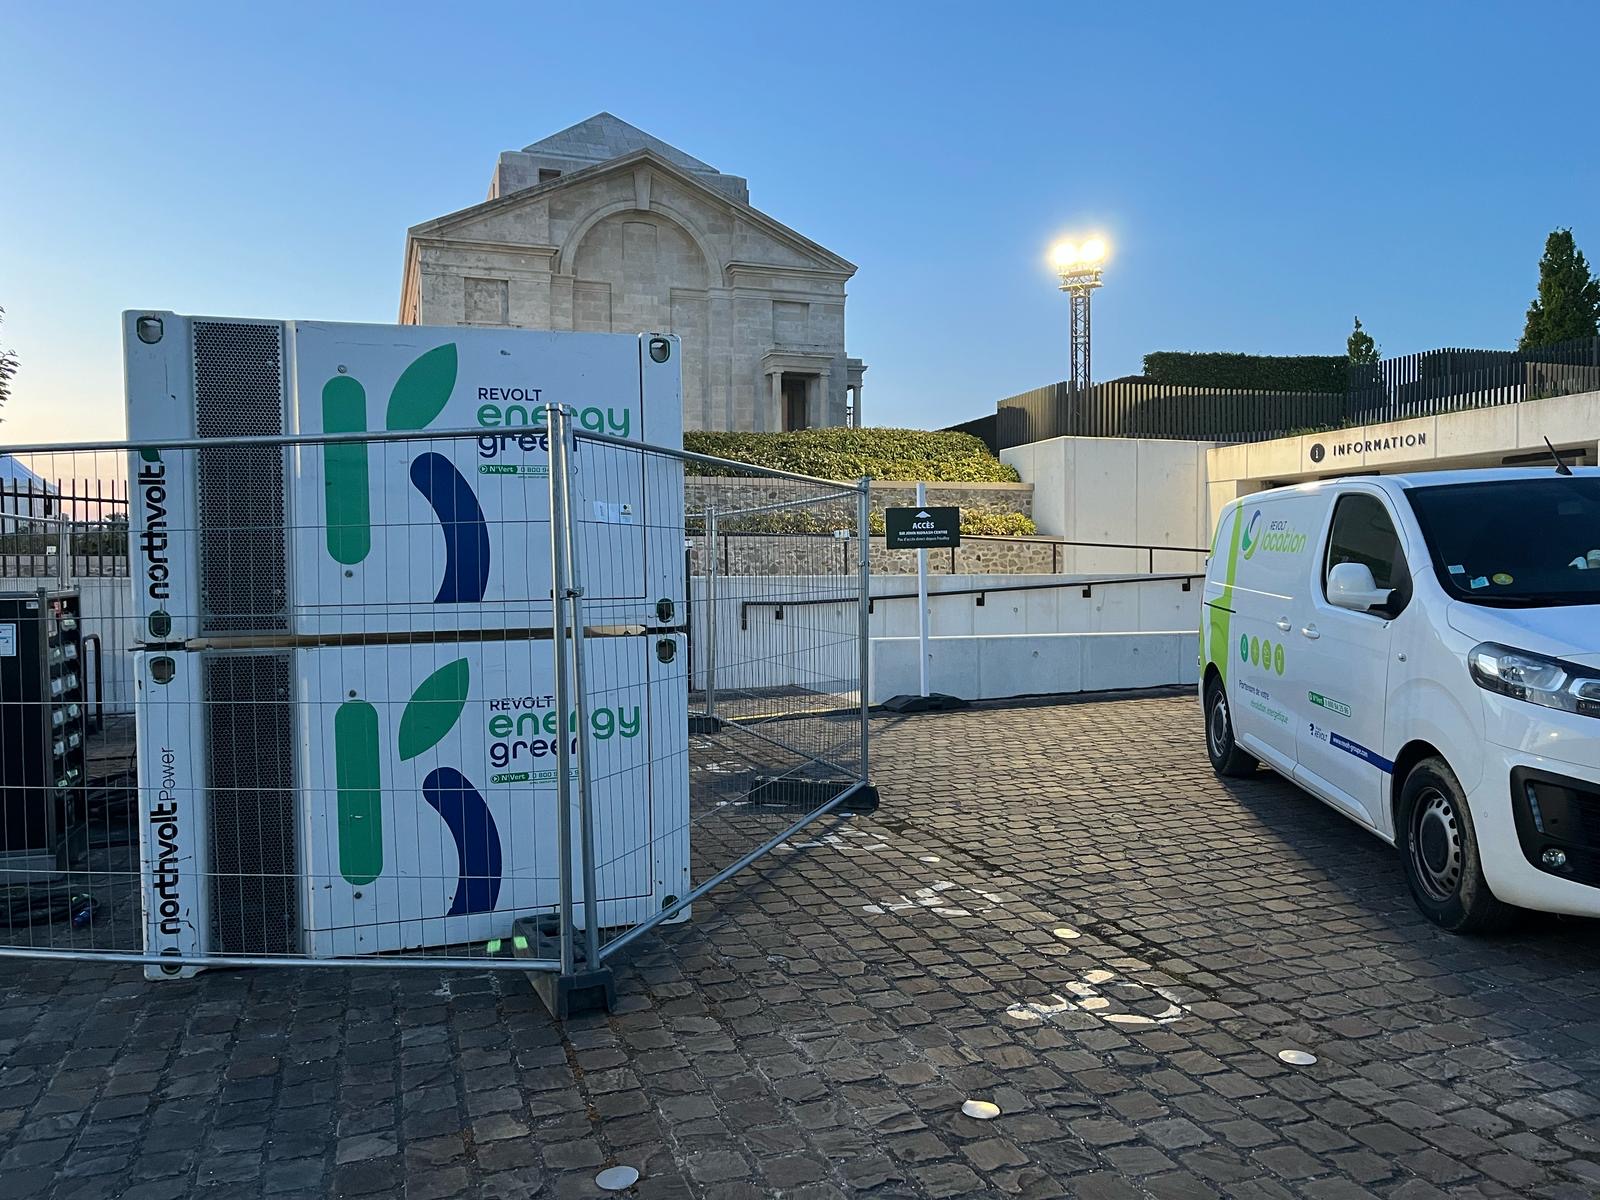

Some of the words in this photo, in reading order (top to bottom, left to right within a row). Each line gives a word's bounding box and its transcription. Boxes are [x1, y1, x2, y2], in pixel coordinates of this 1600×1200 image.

[478, 387, 543, 402] REVOLT
[477, 403, 630, 439] enegy
[478, 431, 578, 458] gre
[1333, 432, 1427, 457] INFORMATION
[137, 464, 170, 600] northvolt
[912, 520, 935, 530] ACCÈS
[1261, 528, 1306, 554] location
[489, 696, 554, 712] REVOLT
